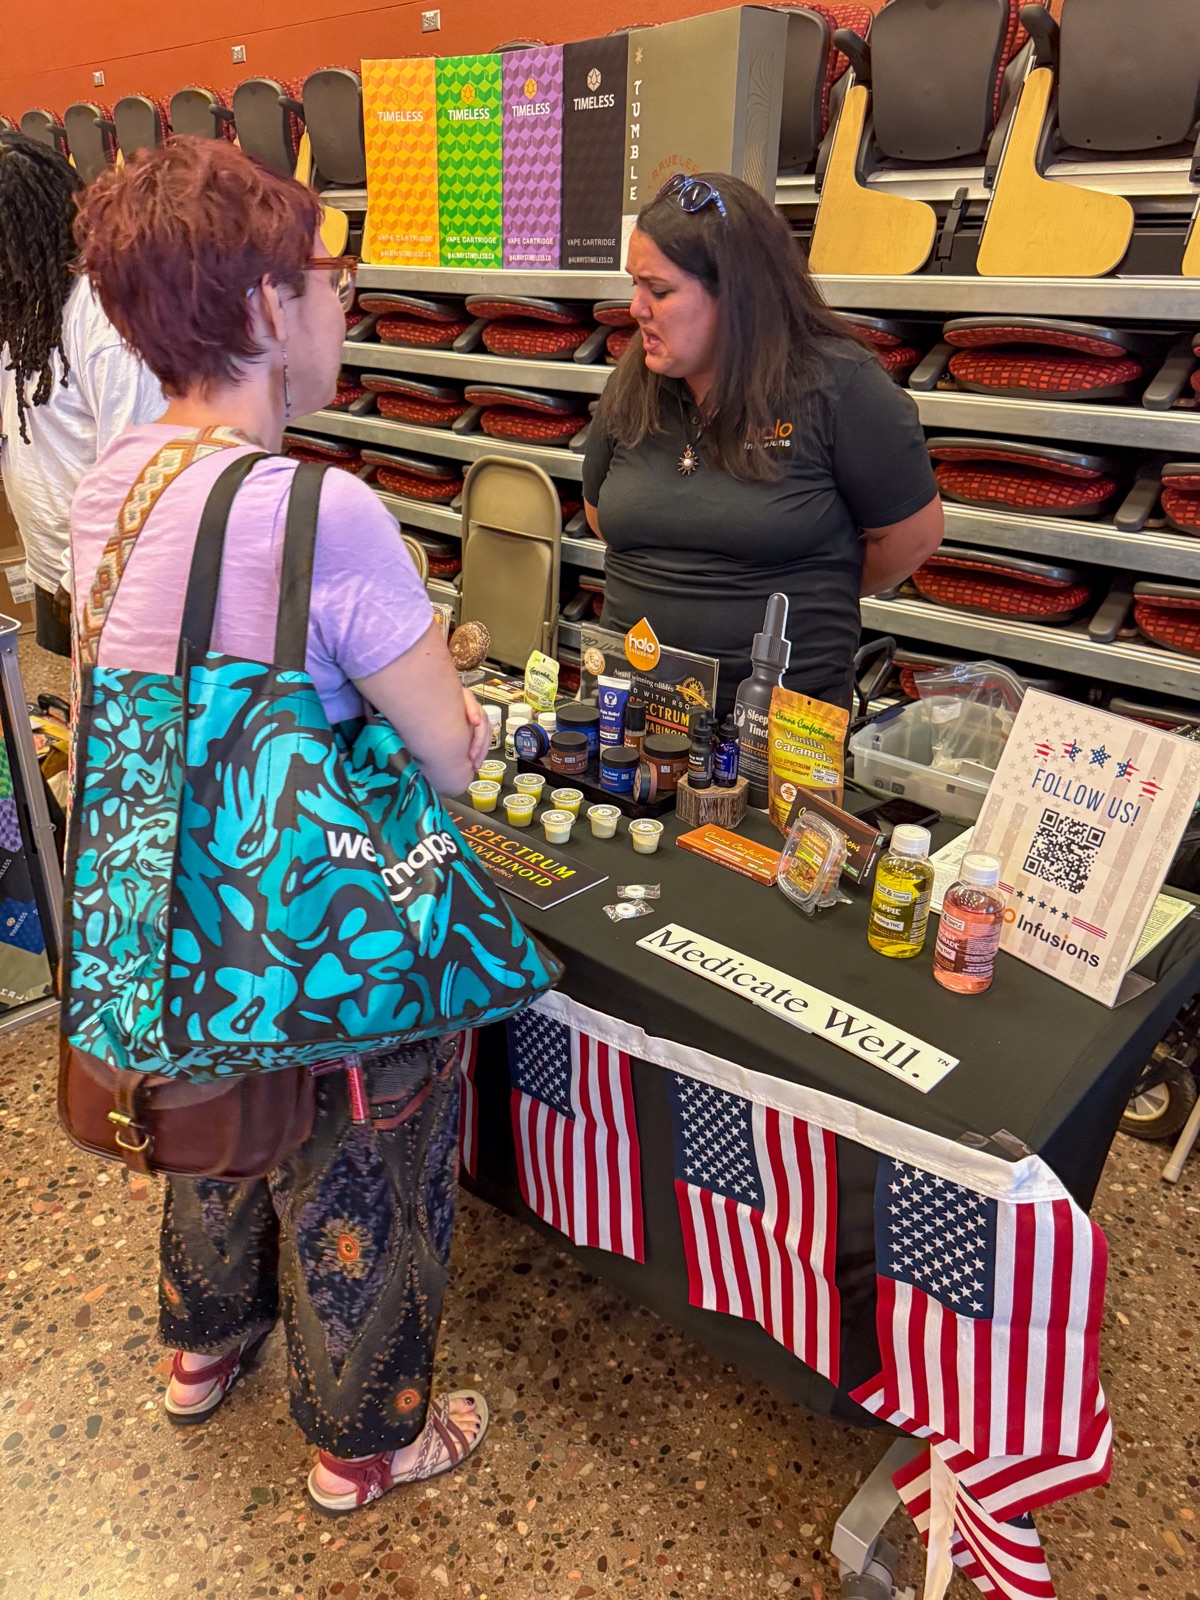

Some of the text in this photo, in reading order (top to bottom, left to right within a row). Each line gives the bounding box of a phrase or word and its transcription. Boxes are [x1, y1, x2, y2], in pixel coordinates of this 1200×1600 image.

[511, 102, 551, 118] TIMELESS
[573, 94, 615, 111] TIMELESS
[377, 110, 424, 123] TIMELESS
[447, 107, 491, 121] TIMELESS
[629, 79, 643, 201] TUMBLE
[377, 234, 433, 243] VAPE CARTRIDGE
[445, 236, 497, 244] VAPE CARTRIDGE
[507, 237, 554, 245] VAPE CARTRIDGE
[582, 238, 616, 246] CARTRIDGE
[628, 633, 656, 654] halo
[613, 669, 674, 693] Award winning edibles
[643, 690, 667, 704] WITH
[671, 699, 690, 710] RSO
[746, 708, 769, 727] Sleep
[775, 709, 836, 742] Canna Confections
[749, 722, 769, 739] Tinct
[784, 728, 826, 751] Vanilla
[774, 738, 834, 765] Caramels
[1031, 767, 1142, 828] FOLLOW US!
[464, 824, 577, 880] SPECTRUM
[705, 831, 731, 845] Canna
[731, 843, 778, 866] Confections
[467, 840, 553, 887] NNABINOID
[878, 903, 902, 916] APPLE
[8, 911, 29, 938] TIMELESS
[1016, 915, 1101, 968] Infusions
[643, 928, 809, 1014] Medicate
[822, 1004, 921, 1079] Well.
